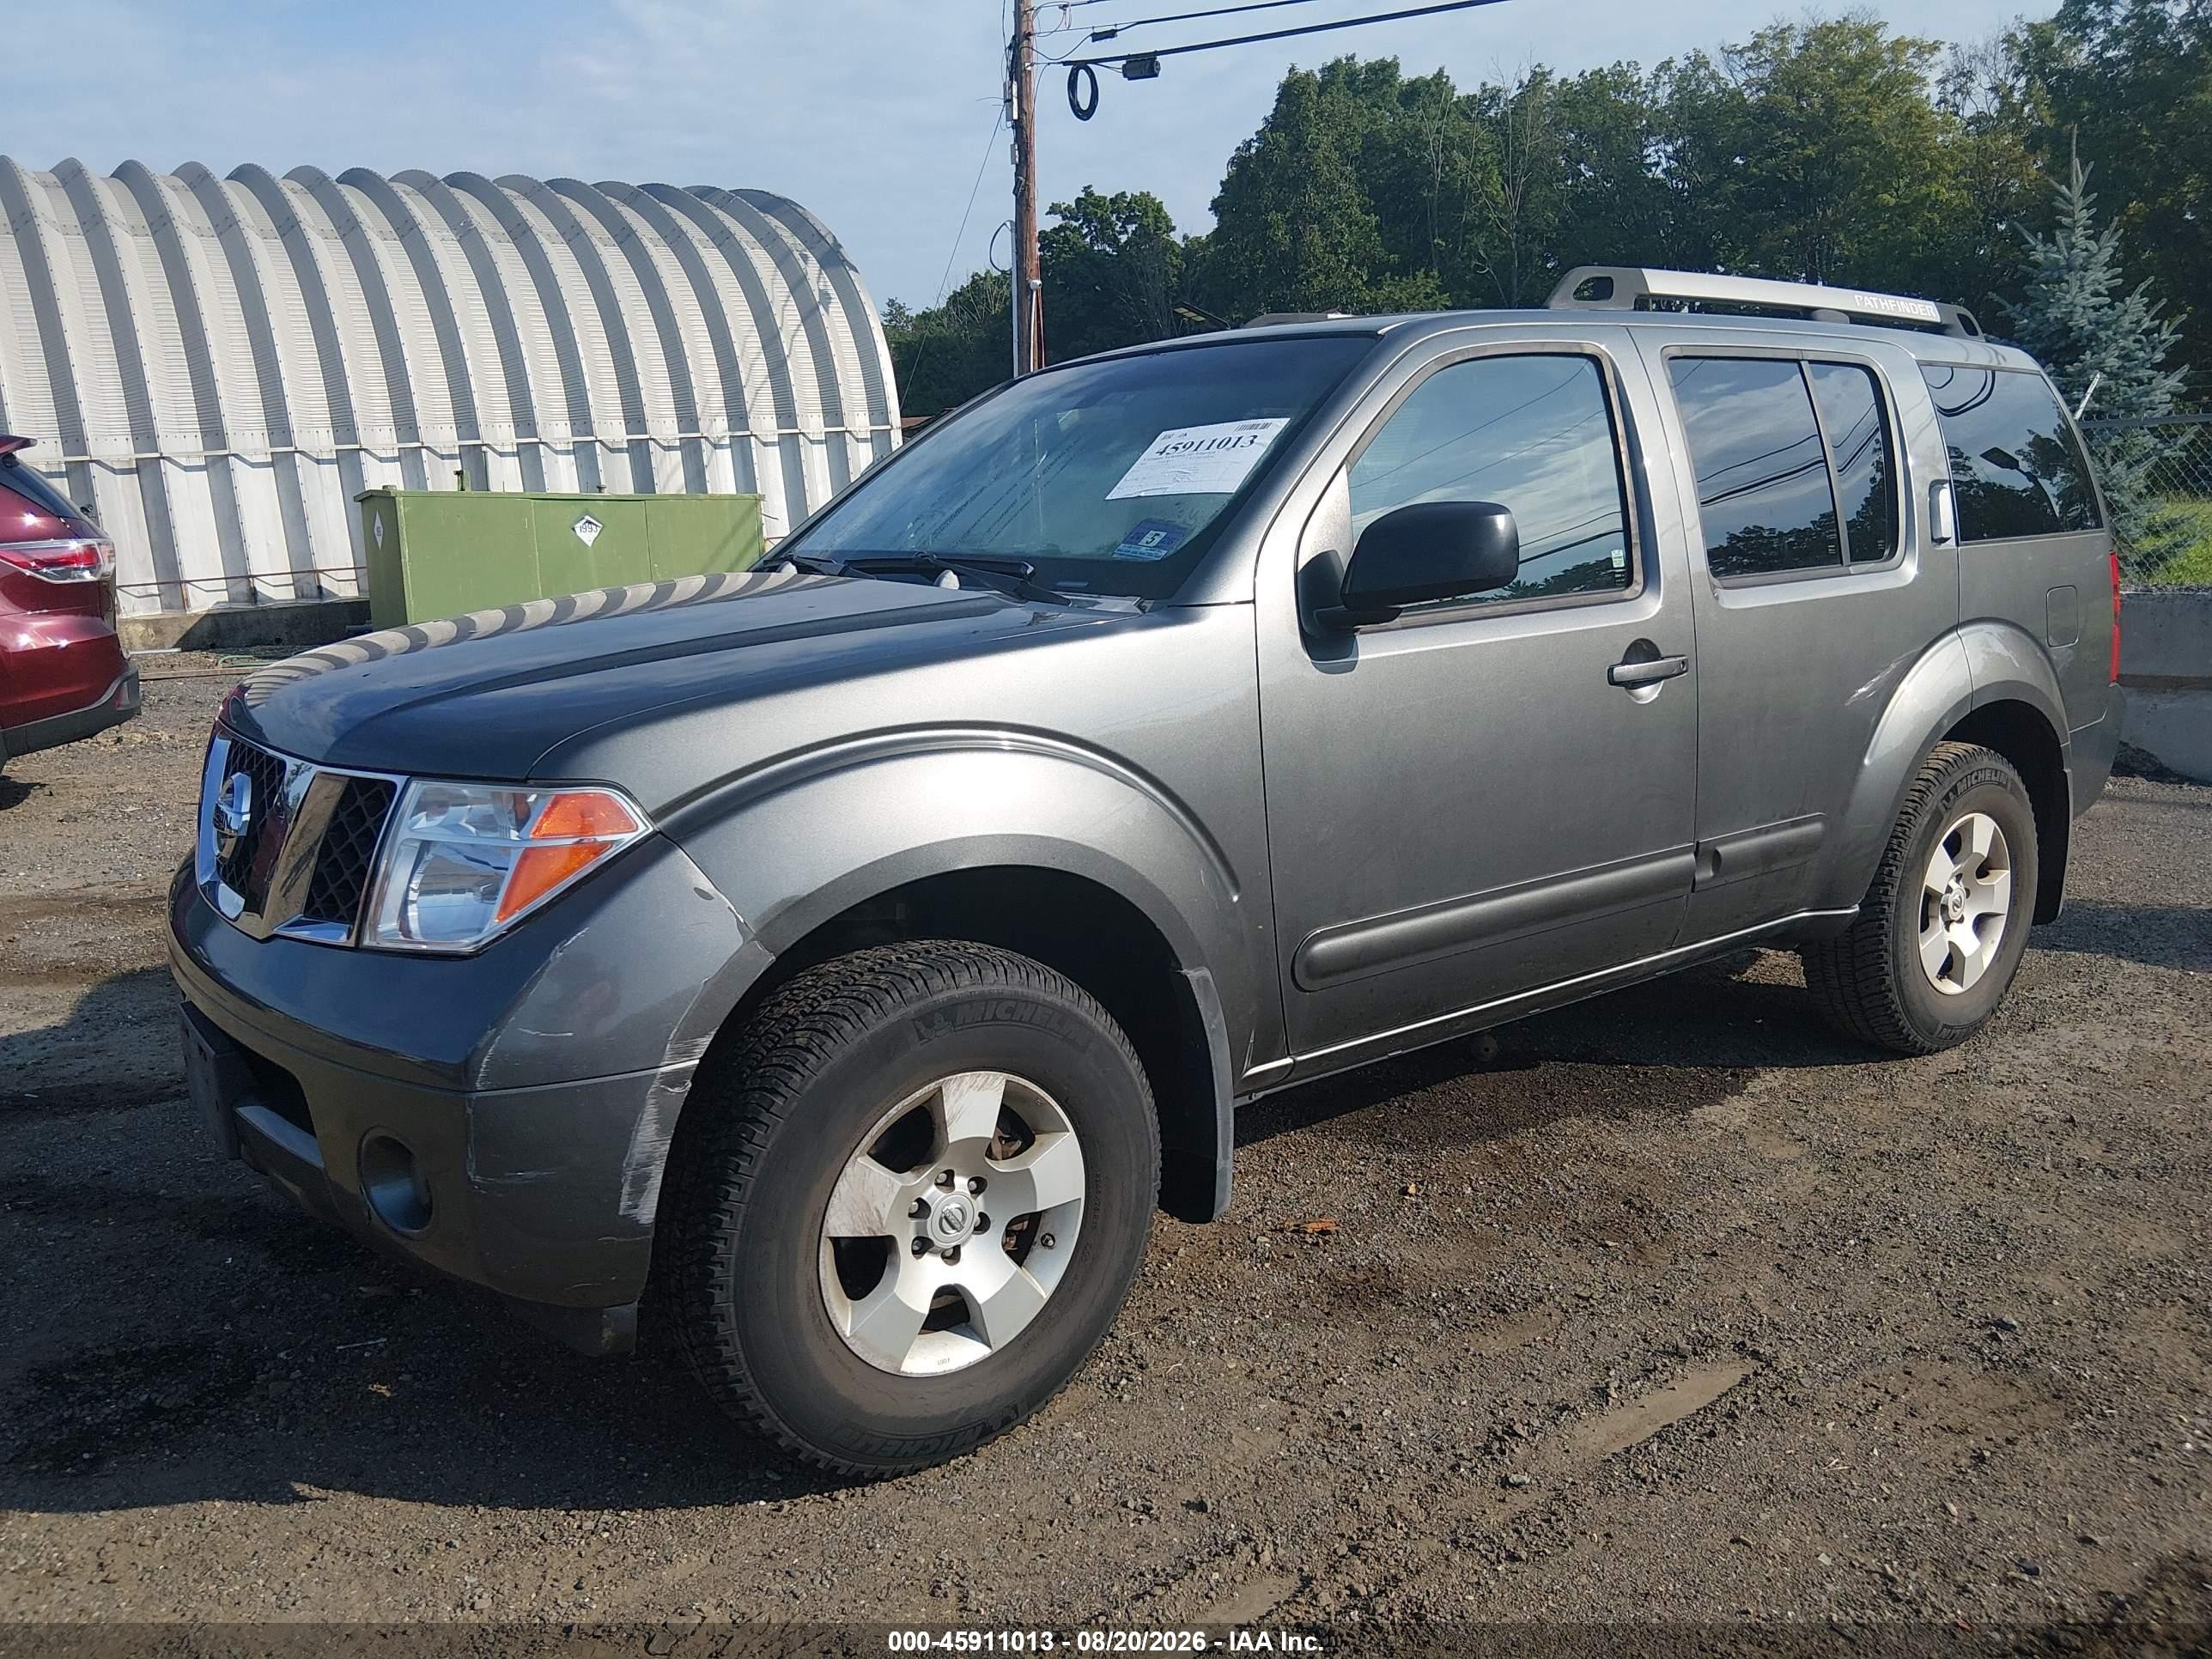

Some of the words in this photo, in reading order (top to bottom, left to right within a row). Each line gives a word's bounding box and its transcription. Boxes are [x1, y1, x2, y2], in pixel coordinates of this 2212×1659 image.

[1855, 295, 1936, 317] PATHFINDER
[1155, 434, 1258, 455] 45911013
[579, 521, 599, 533] 1993
[1956, 768, 2008, 796] MICHELIN
